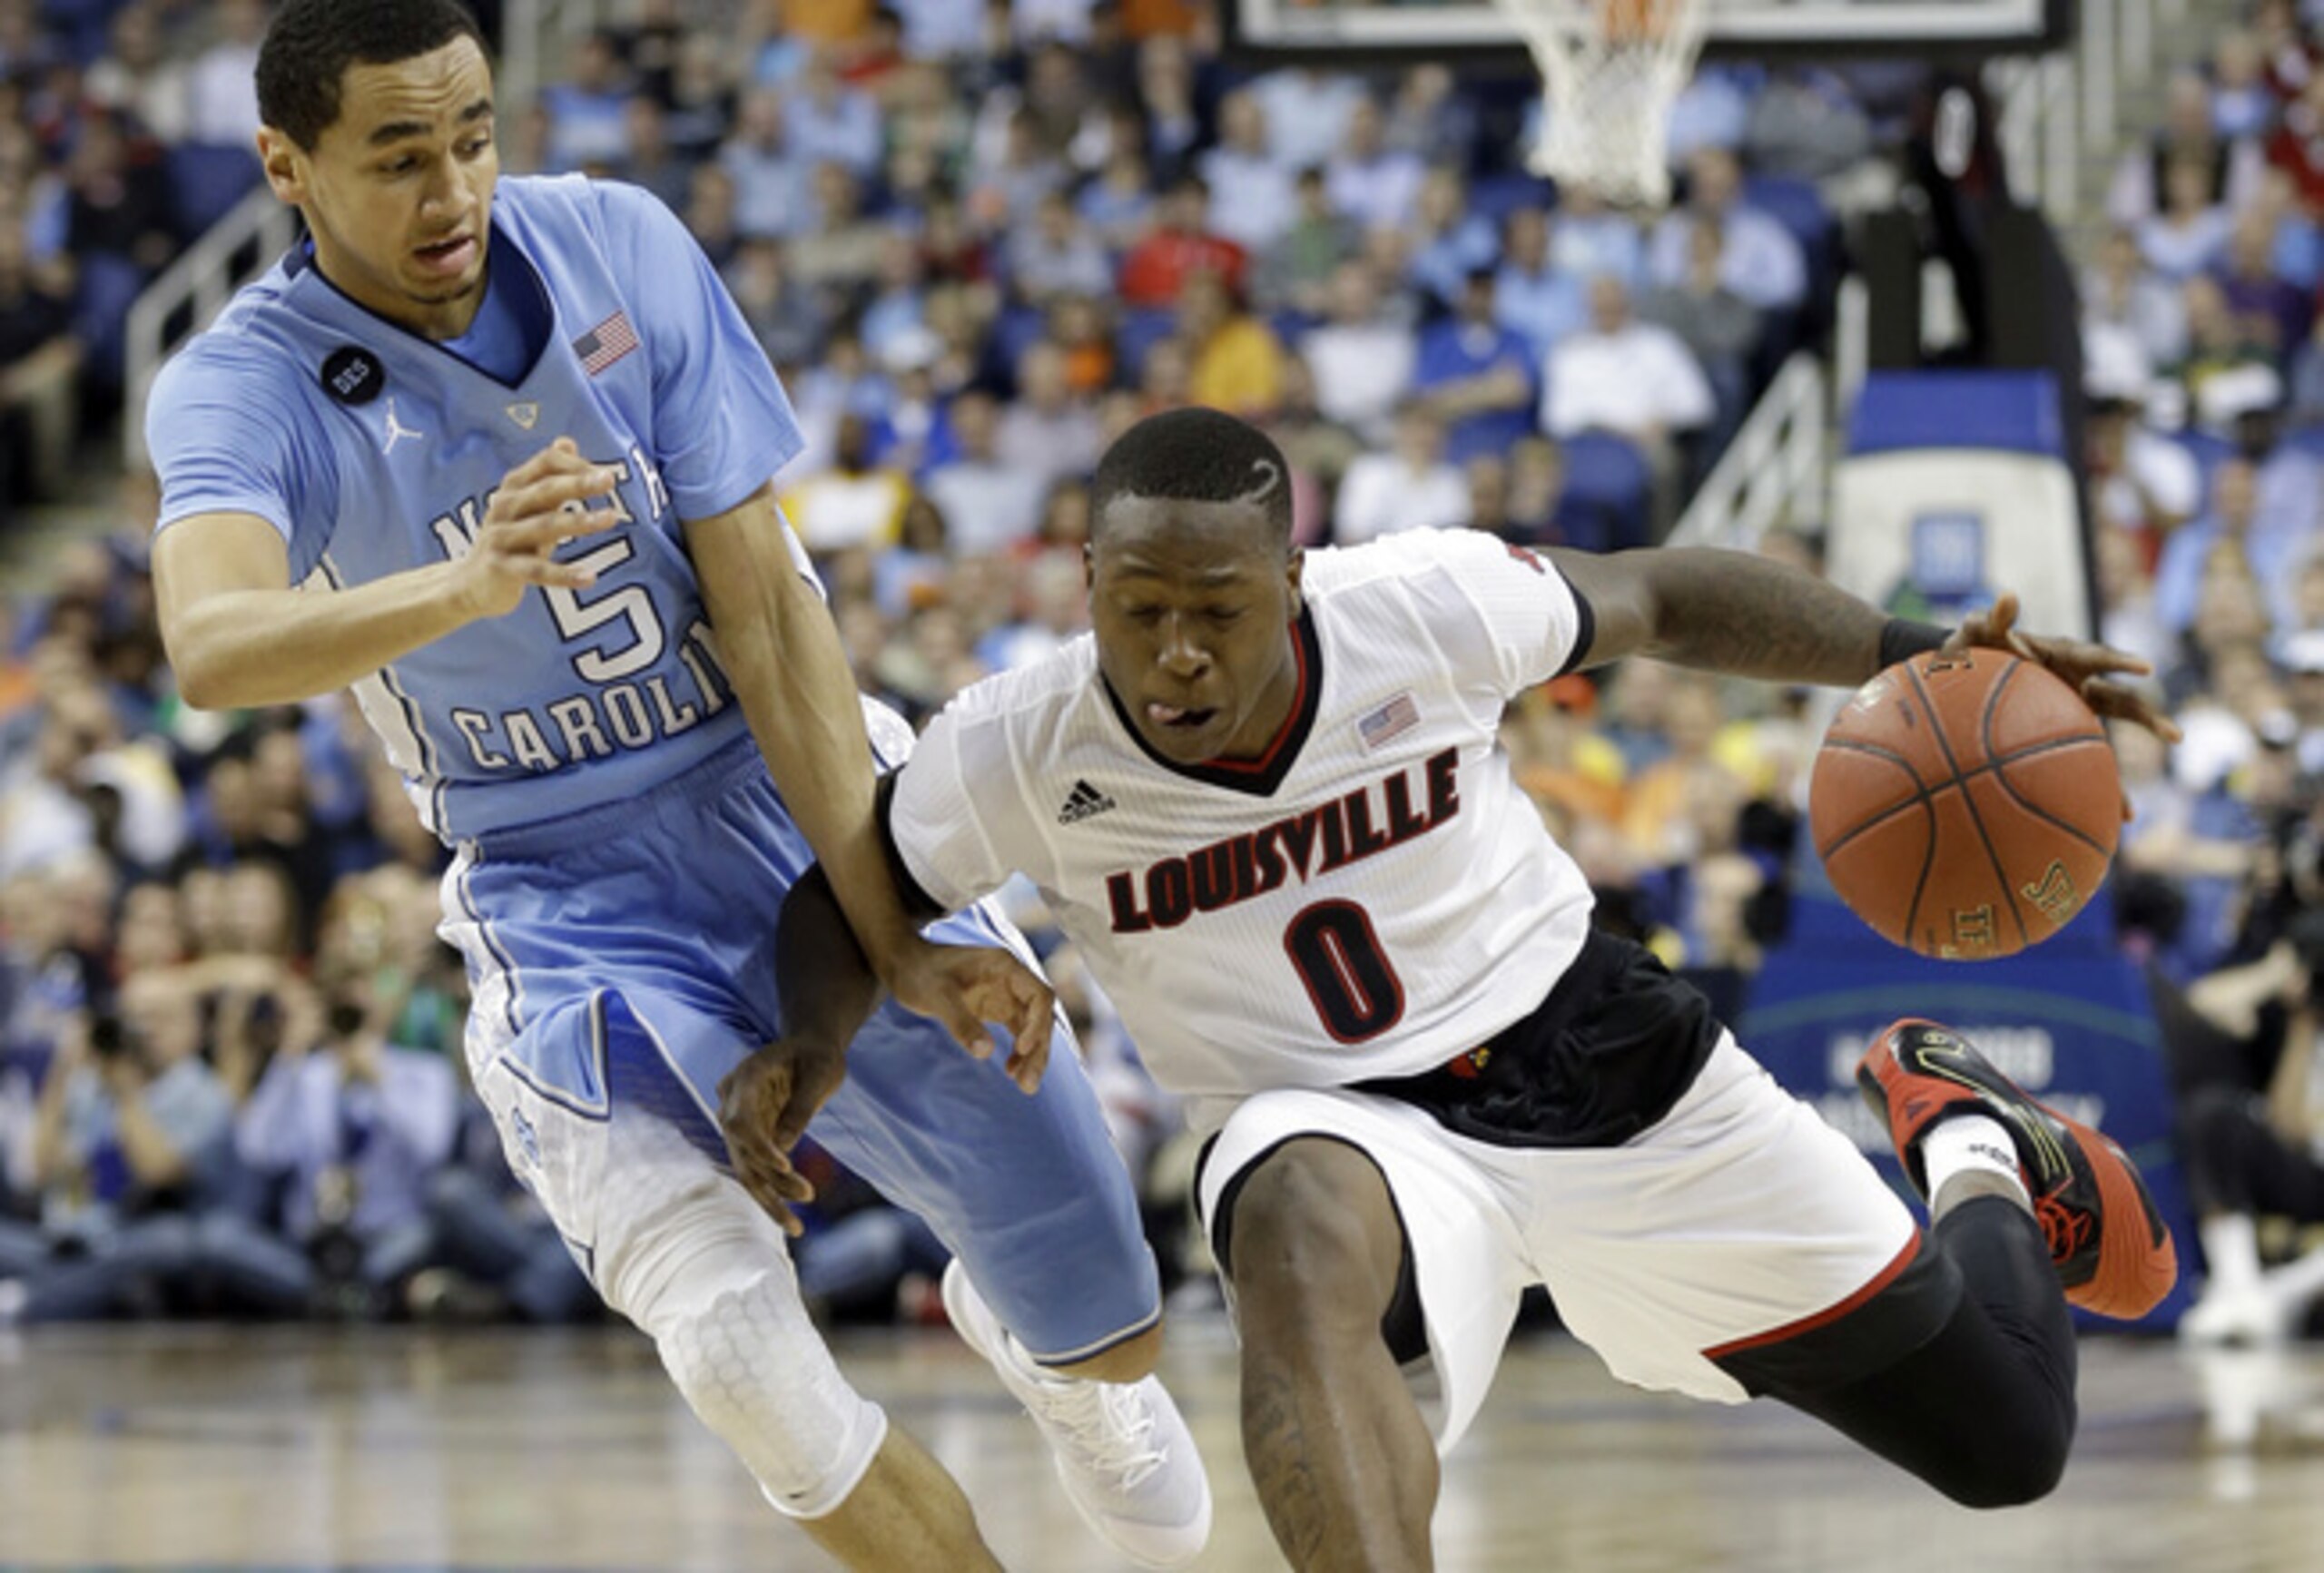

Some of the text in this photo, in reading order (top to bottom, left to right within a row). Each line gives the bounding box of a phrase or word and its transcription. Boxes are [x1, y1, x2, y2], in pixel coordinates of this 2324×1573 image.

[539, 535, 665, 685] 5
[1106, 746, 1460, 934] LOUISVILLE
[1283, 897, 1406, 1046] 0
